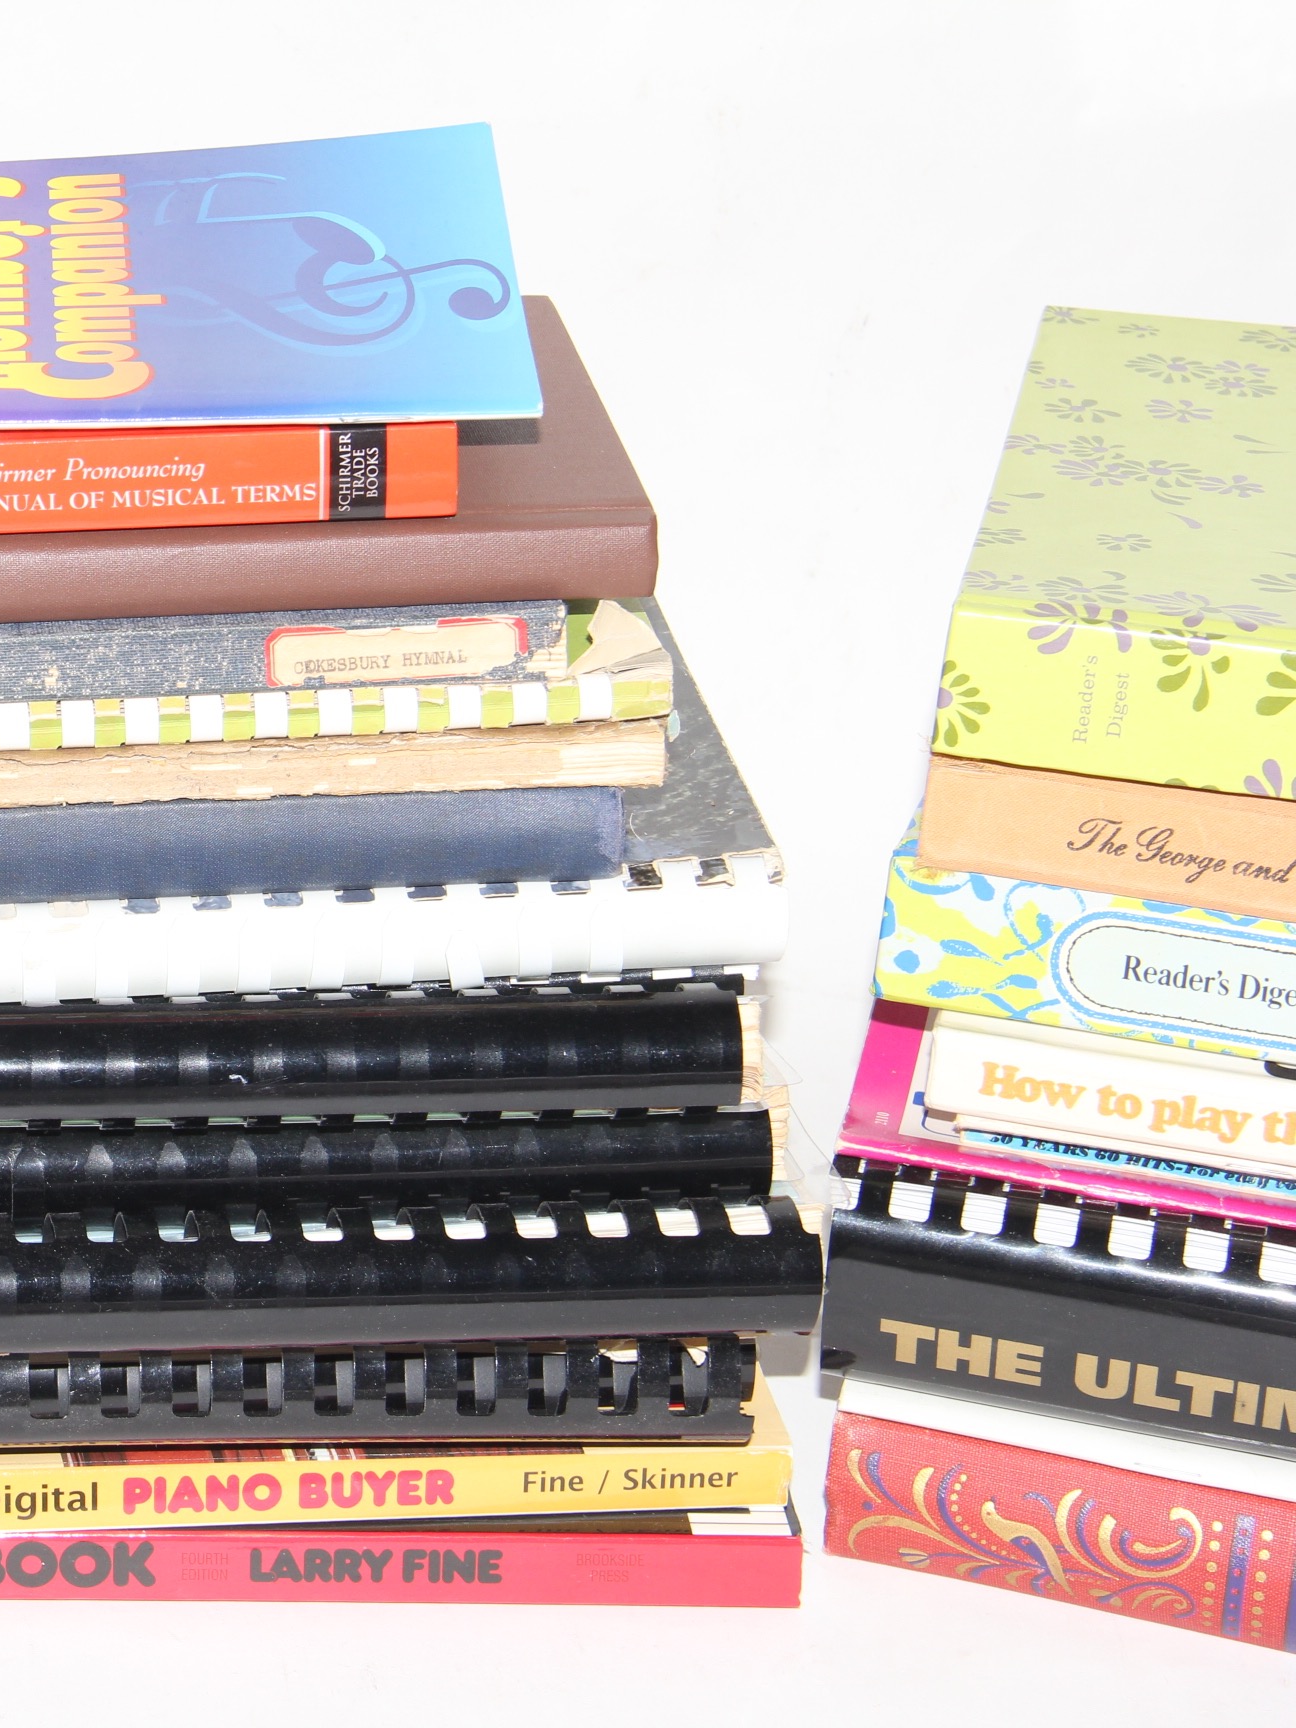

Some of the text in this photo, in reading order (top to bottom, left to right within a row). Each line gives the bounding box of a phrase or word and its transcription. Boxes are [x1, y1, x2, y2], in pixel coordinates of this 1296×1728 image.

[7, 173, 167, 400] Companion
[63, 456, 205, 482] Pronouncing
[338, 433, 352, 512] SCHIRMER
[352, 449, 365, 498] TRADE
[366, 447, 379, 499] BOOKS
[69, 491, 105, 510] OF
[112, 487, 225, 508] MUSICAL
[231, 483, 317, 504] TERMS
[402, 649, 468, 667] HYMNAL
[1072, 655, 1098, 744] Reader's
[1106, 672, 1130, 738] Digest
[1066, 818, 1296, 883] The George and
[1122, 954, 1230, 996] Reader's
[978, 1061, 1086, 1110] How
[1096, 1084, 1142, 1120] to
[1147, 1094, 1252, 1144] play
[1021, 1137, 1089, 1157] YEARS
[1094, 1150, 1120, 1162] 60
[880, 1318, 1044, 1387] THE
[122, 1472, 283, 1515] PIANO
[298, 1469, 455, 1510] BUYER
[523, 1469, 584, 1494] Fine
[598, 1470, 609, 1494] /
[622, 1466, 739, 1491] Skinner
[181, 1553, 229, 1566] FOURTH
[181, 1568, 228, 1581] EDITION
[250, 1549, 502, 1584] LARRY FINE
[576, 1553, 644, 1567] BROOKSIDE
[591, 1570, 629, 1583] PRESS
